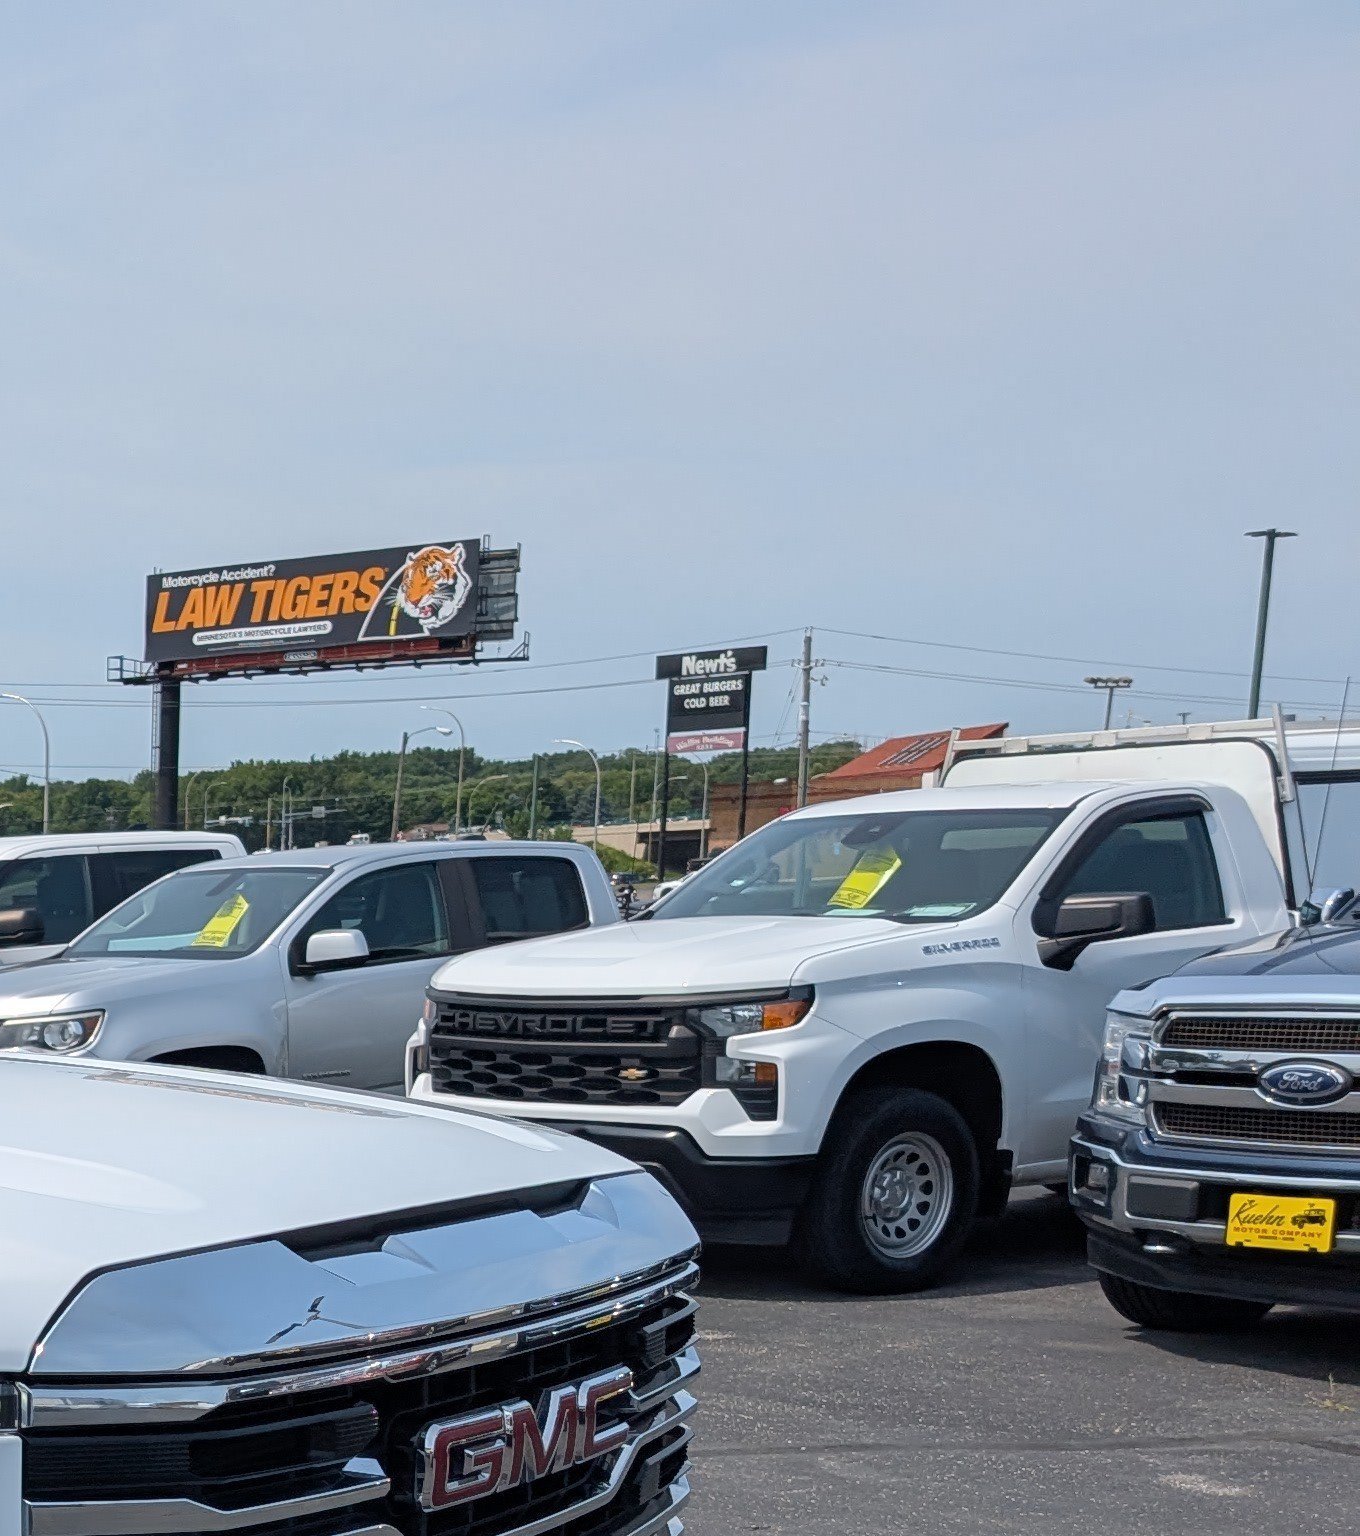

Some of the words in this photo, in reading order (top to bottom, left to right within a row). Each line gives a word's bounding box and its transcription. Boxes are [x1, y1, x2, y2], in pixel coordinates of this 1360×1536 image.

[162, 570, 218, 588] Motorcycle
[221, 564, 276, 582] Accident?
[152, 583, 246, 633] LAW
[250, 567, 385, 623] TIGERS
[244, 626, 292, 638] MOTORCYCLE
[681, 650, 737, 676] Newt's
[673, 682, 701, 696] GREAT
[702, 679, 744, 693] BURGERS
[683, 697, 707, 709] COLD
[708, 695, 731, 707] BEER
[436, 1009, 668, 1035] CHEVROLET
[1278, 1071, 1323, 1091] Ford
[1231, 1200, 1286, 1227] Kuehn
[1233, 1226, 1268, 1235] MOTOR
[1271, 1229, 1322, 1239] COMPANY
[417, 1363, 633, 1512] GMC
